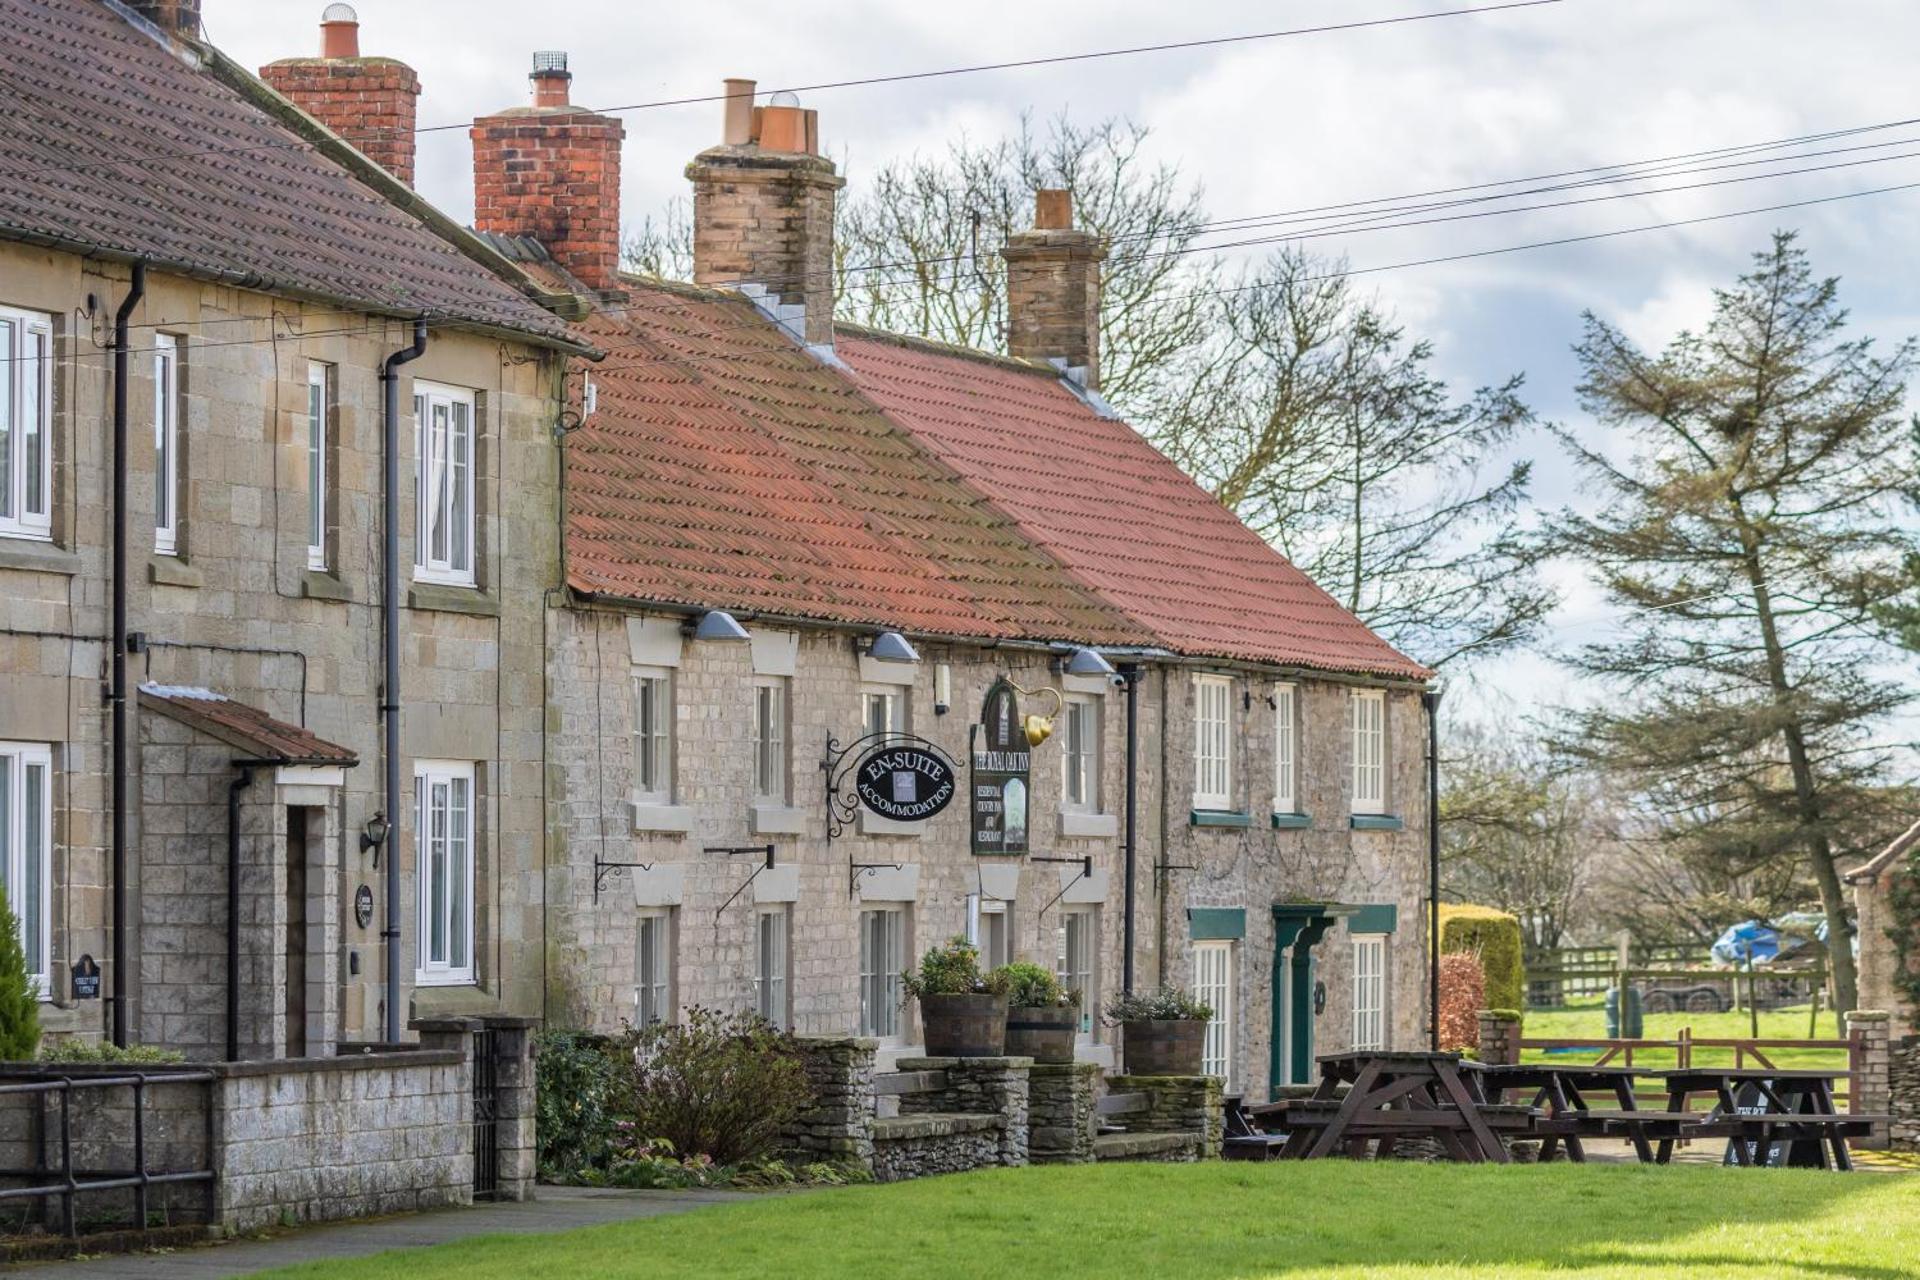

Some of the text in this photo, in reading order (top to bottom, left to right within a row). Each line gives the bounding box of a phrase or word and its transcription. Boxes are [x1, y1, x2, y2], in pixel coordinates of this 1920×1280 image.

[866, 752, 944, 781] EN-SUITE
[973, 751, 1030, 771] THE ROYAL OAK INN
[859, 780, 953, 816] ACCOMMODATION
